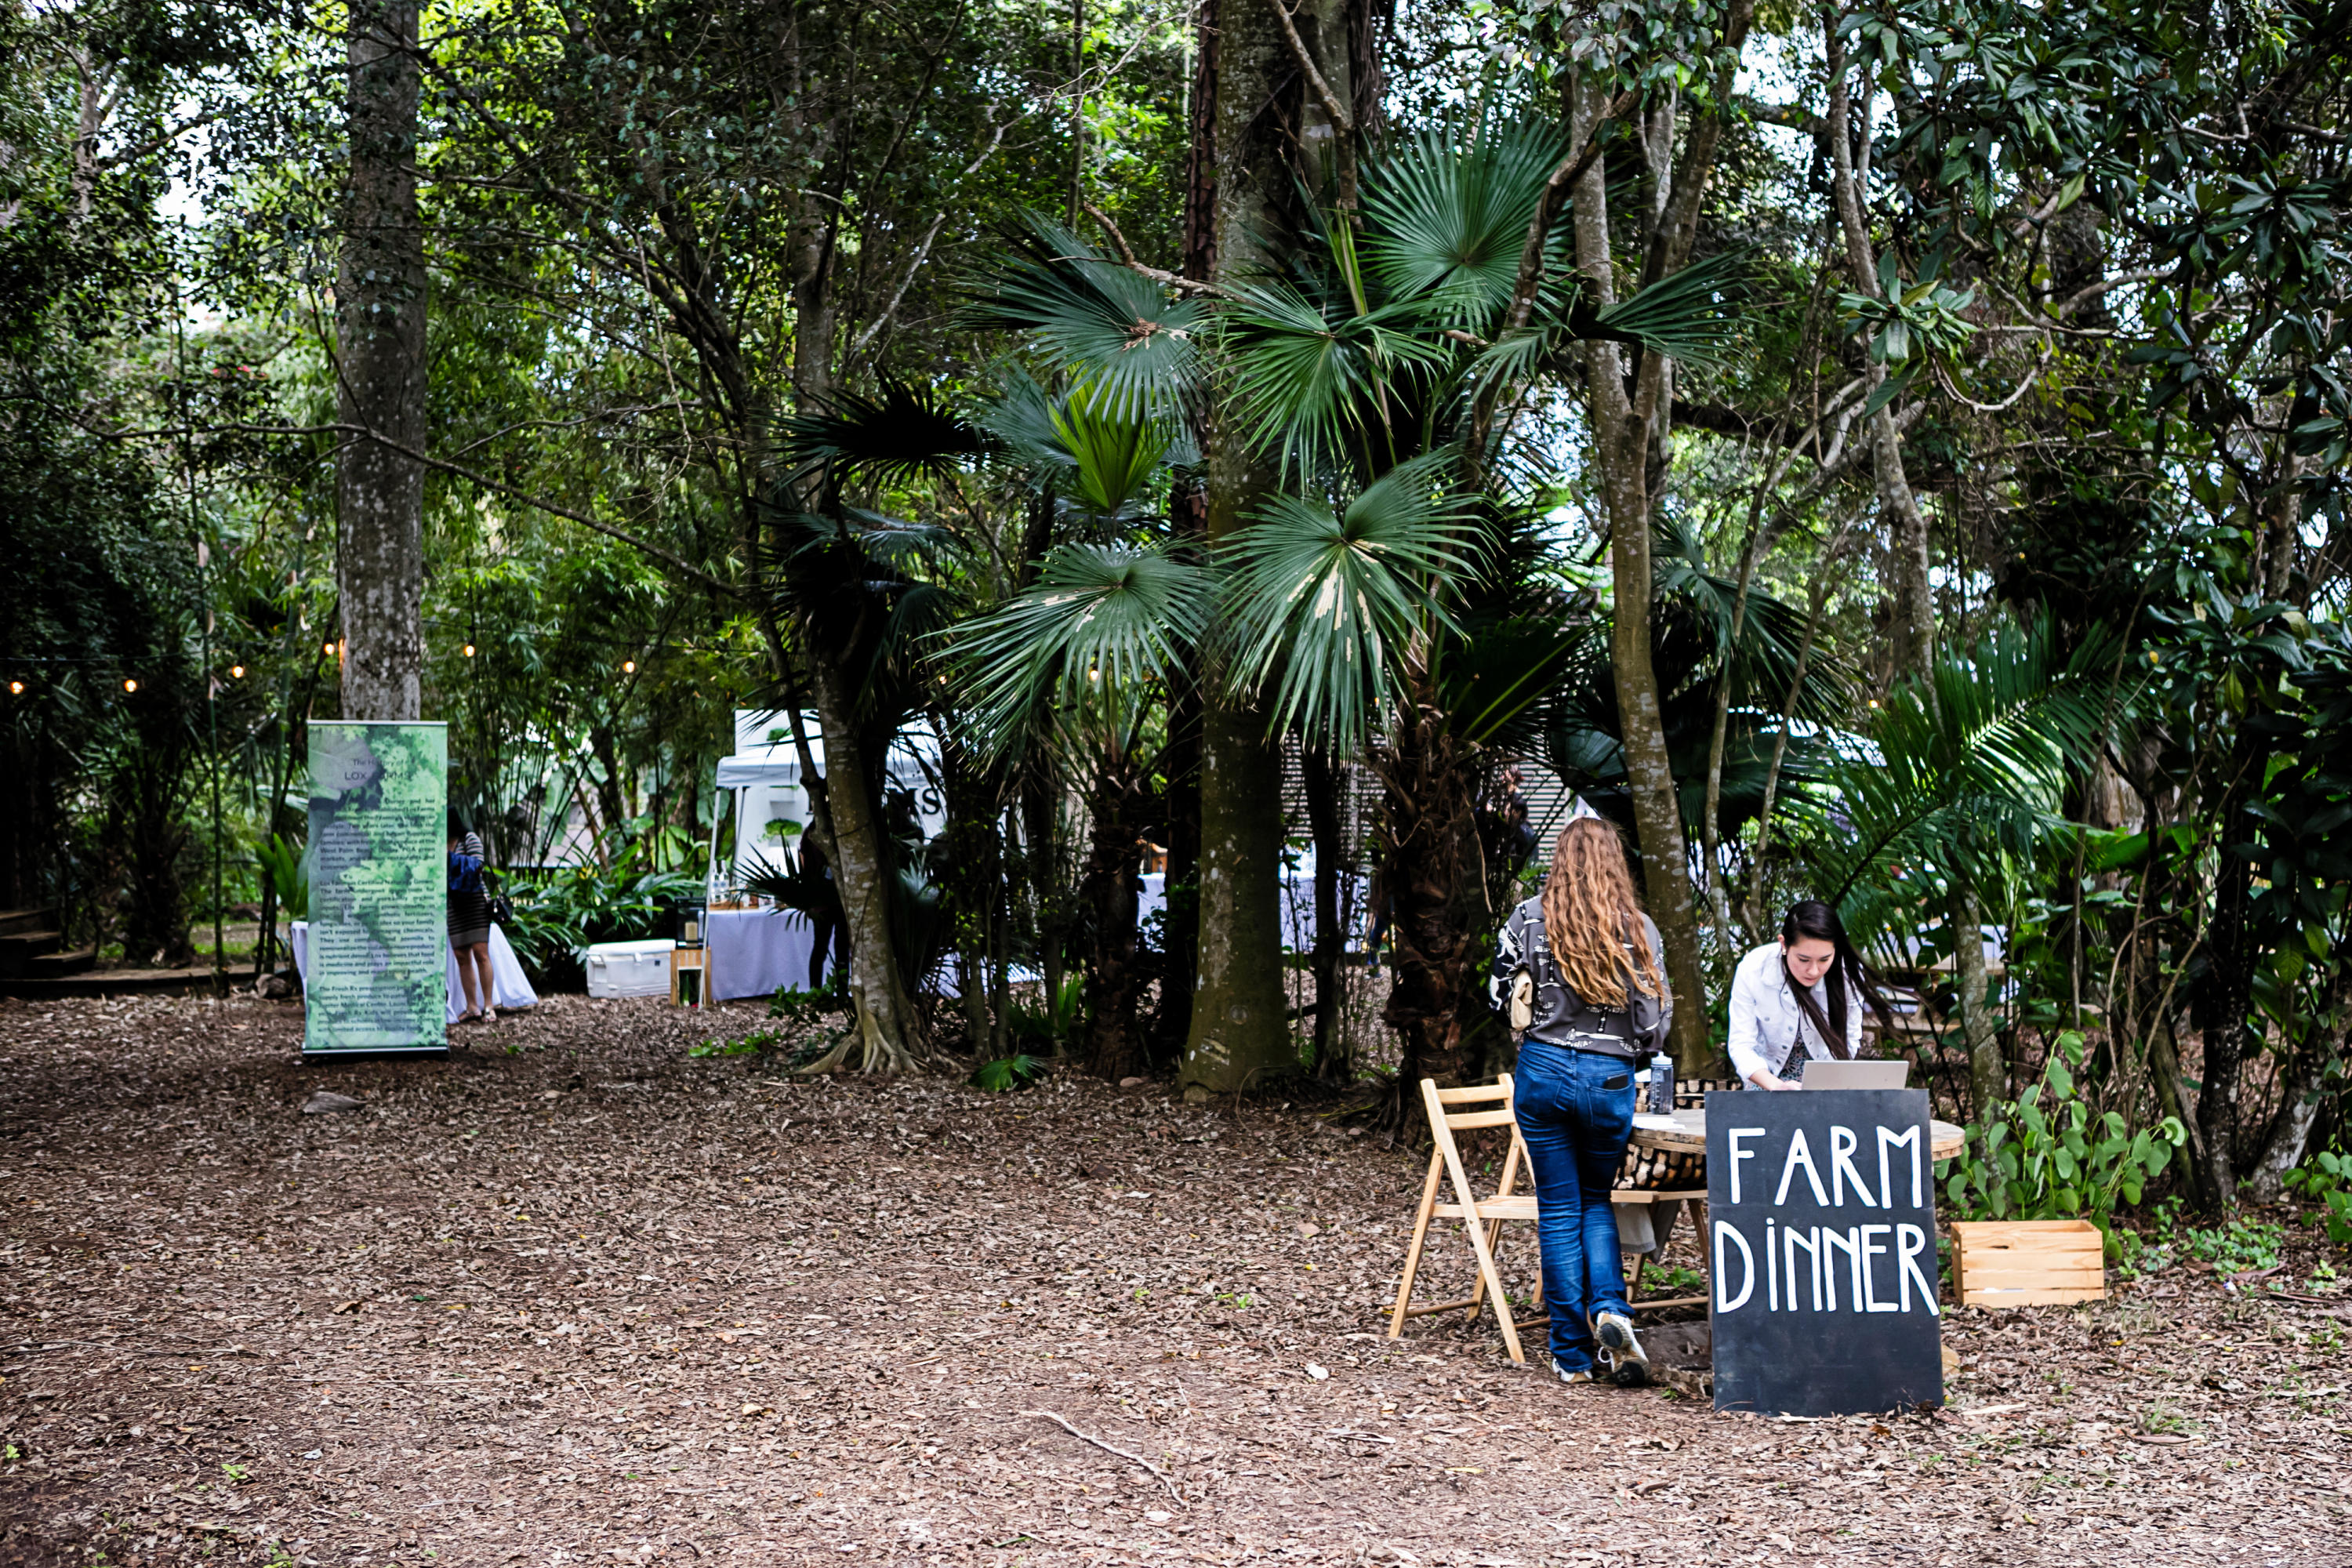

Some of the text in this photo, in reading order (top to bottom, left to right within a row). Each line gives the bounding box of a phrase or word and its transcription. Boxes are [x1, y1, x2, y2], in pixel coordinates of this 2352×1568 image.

[344, 771, 368, 781] LOX
[416, 918, 435, 927] family
[1729, 1125, 1922, 1209] FARM
